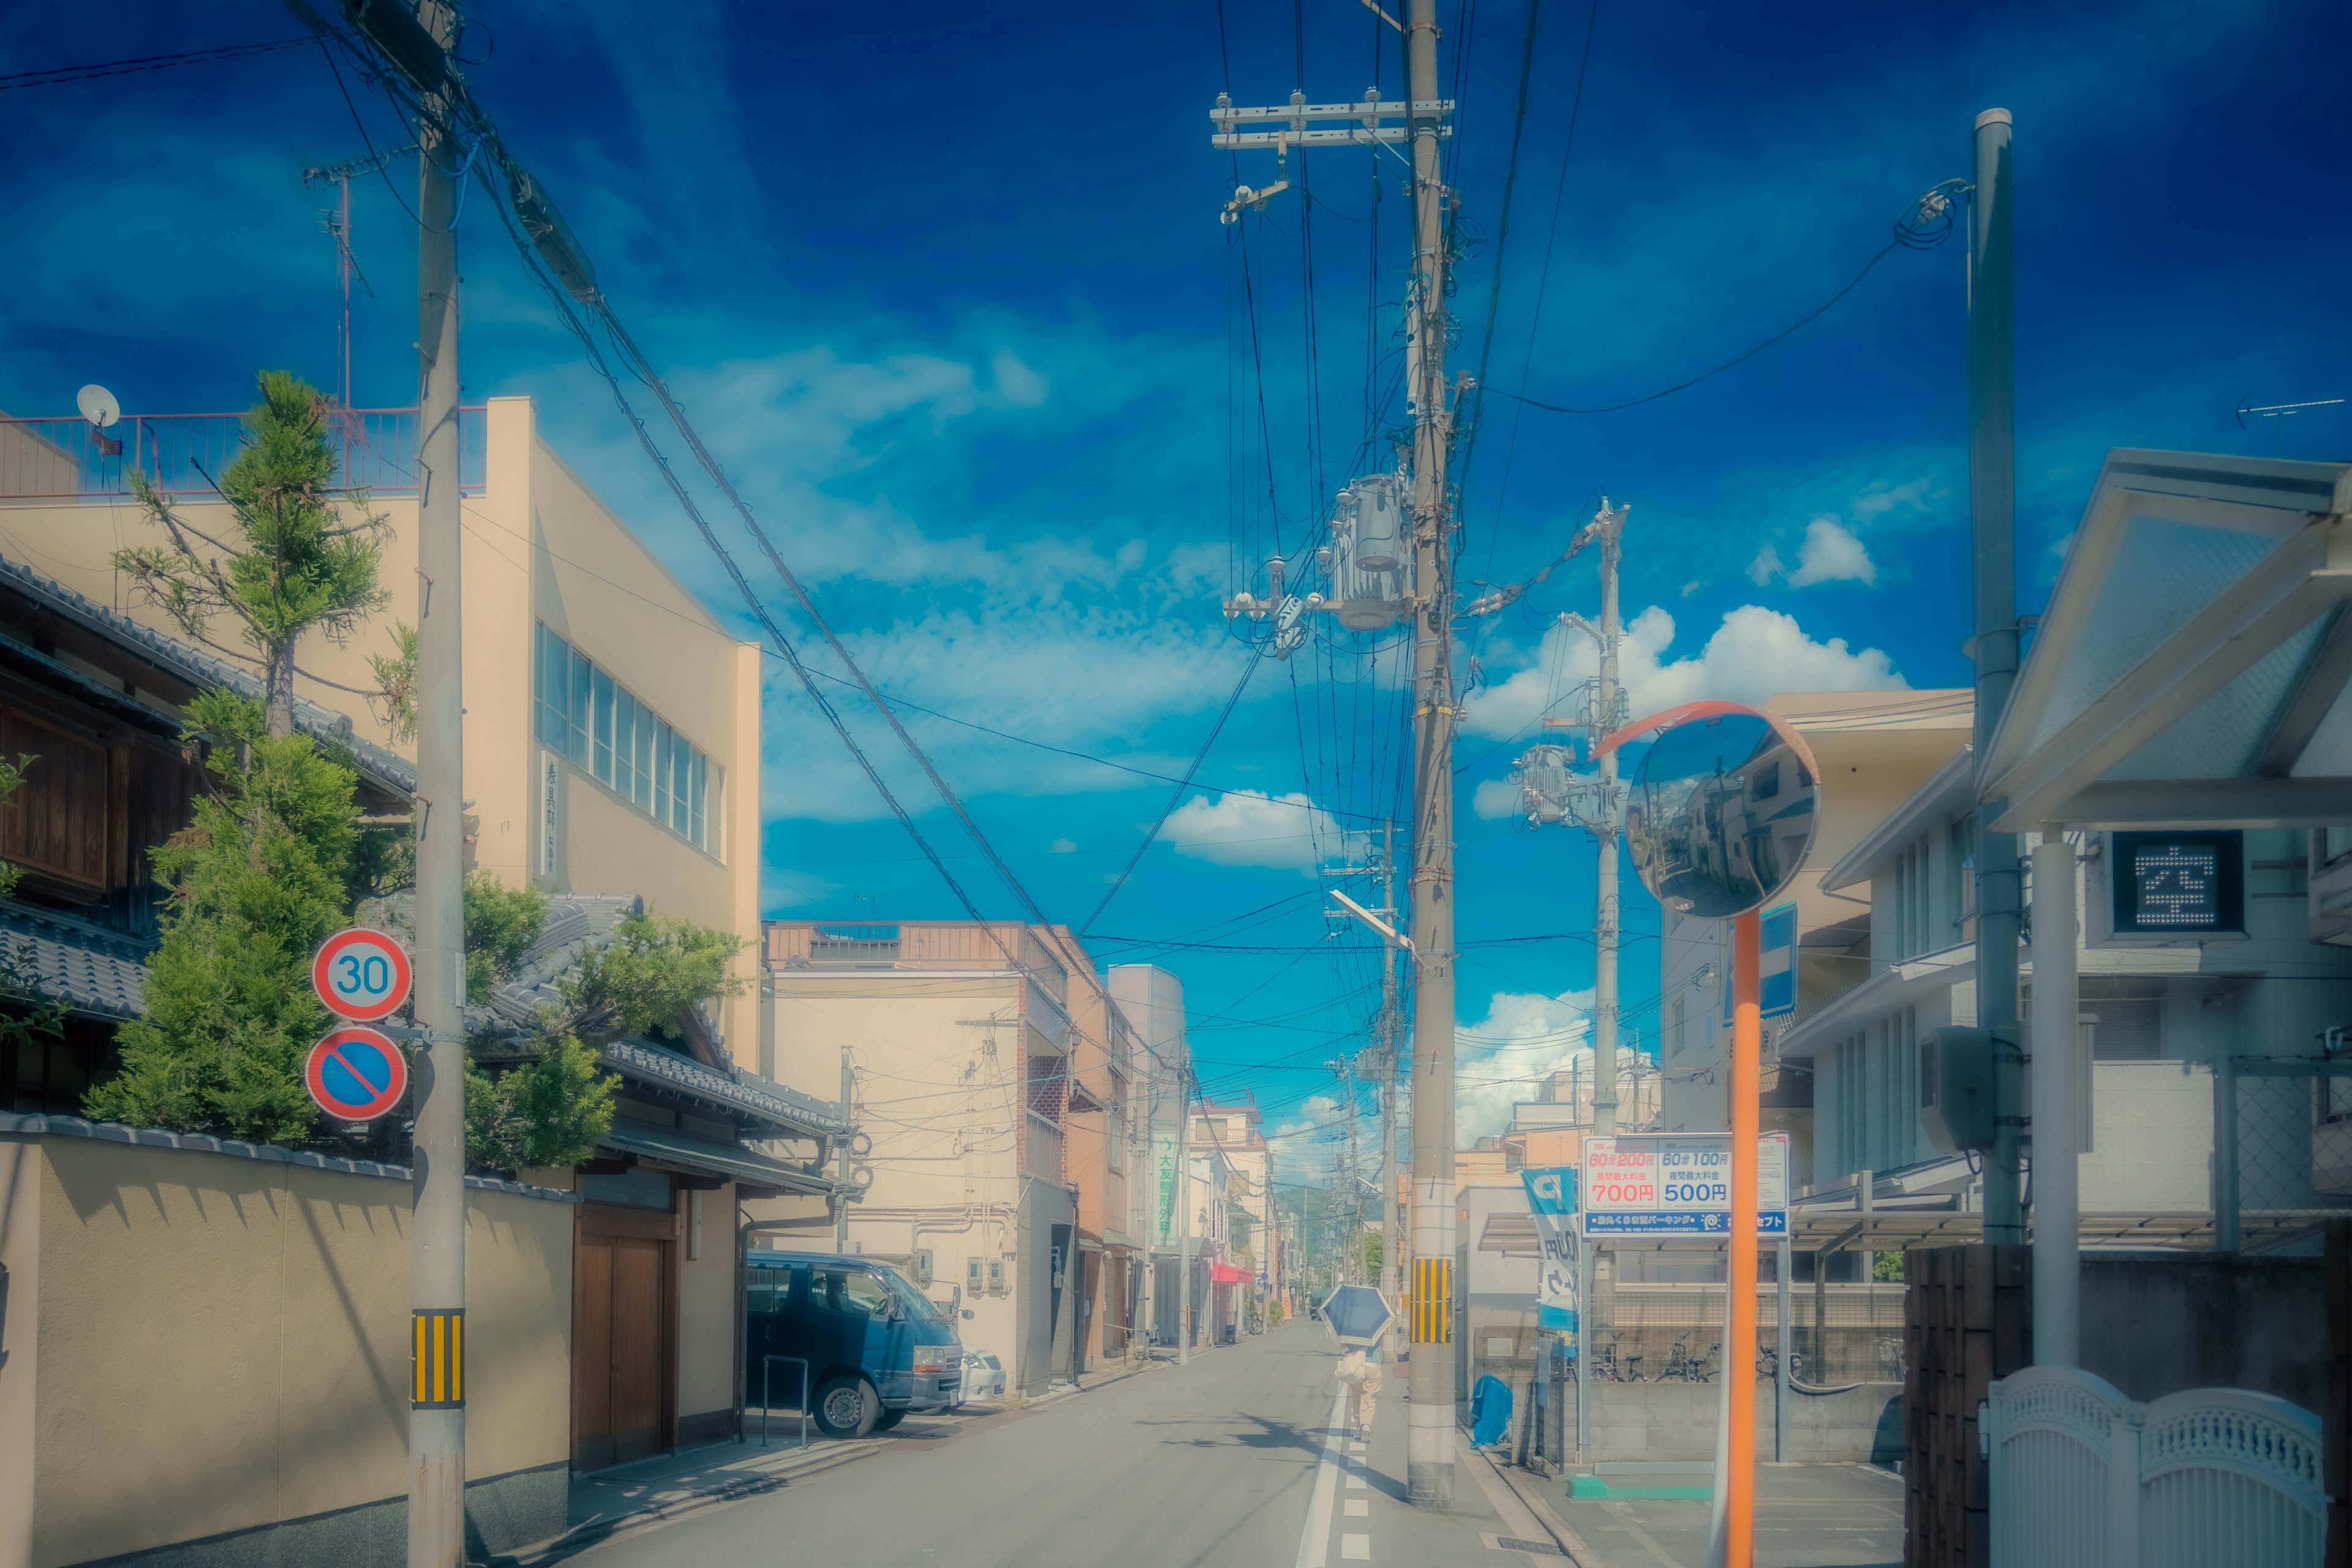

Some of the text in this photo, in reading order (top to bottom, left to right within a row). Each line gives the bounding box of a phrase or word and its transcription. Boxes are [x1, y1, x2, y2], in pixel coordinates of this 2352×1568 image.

[546, 761, 556, 831] 表具師
[2135, 847, 2215, 923] 空
[337, 955, 388, 994] 30
[1589, 1153, 1655, 1166] 60分200円
[1662, 1153, 1728, 1166] 60分100円
[1596, 1172, 1646, 1181] 昼間最大料金
[1670, 1171, 1719, 1180] 夜間最大料金
[1159, 1154, 1172, 1234] 大友整形外科
[1592, 1184, 1654, 1202] 700円
[1665, 1184, 1726, 1202] 500円
